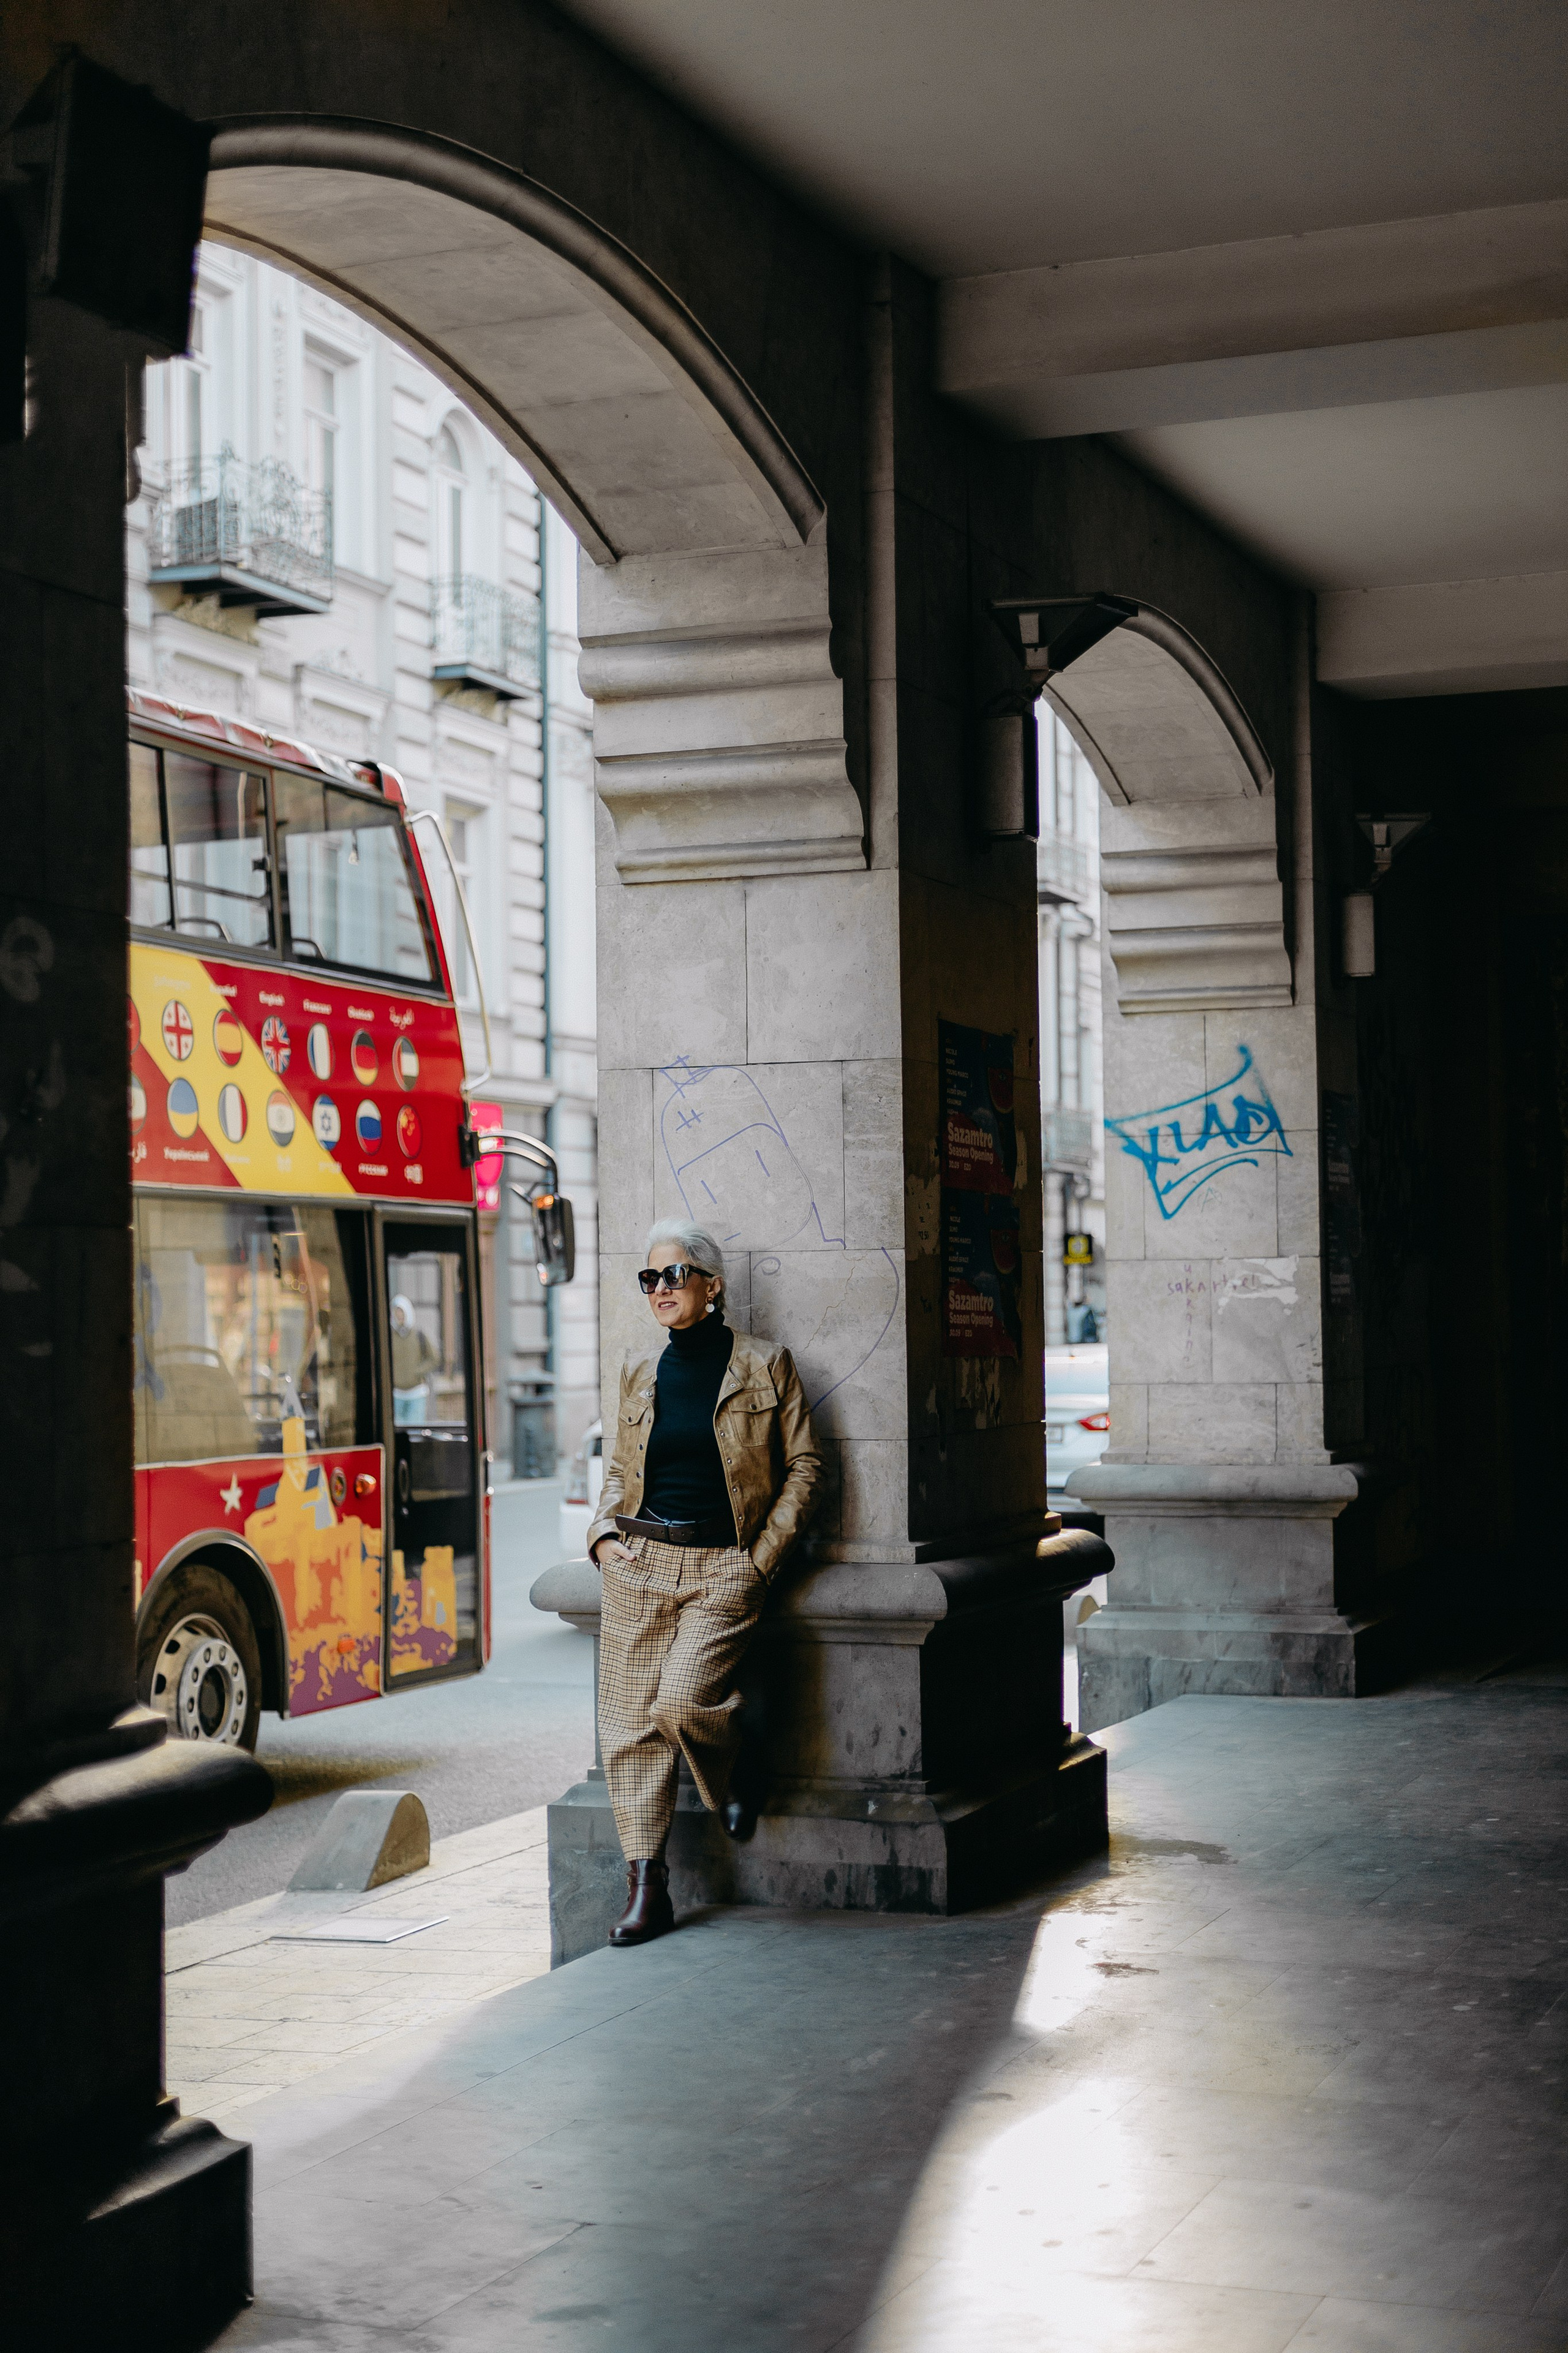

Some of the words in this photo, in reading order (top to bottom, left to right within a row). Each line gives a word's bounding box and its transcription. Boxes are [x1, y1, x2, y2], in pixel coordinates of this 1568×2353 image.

[948, 1121, 993, 1149] Sazamtro
[948, 1143, 969, 1158] Season
[970, 1147, 993, 1165] Opening
[949, 1290, 993, 1312] Sazamtro
[949, 1312, 970, 1324] Season
[971, 1313, 993, 1328] Opening
